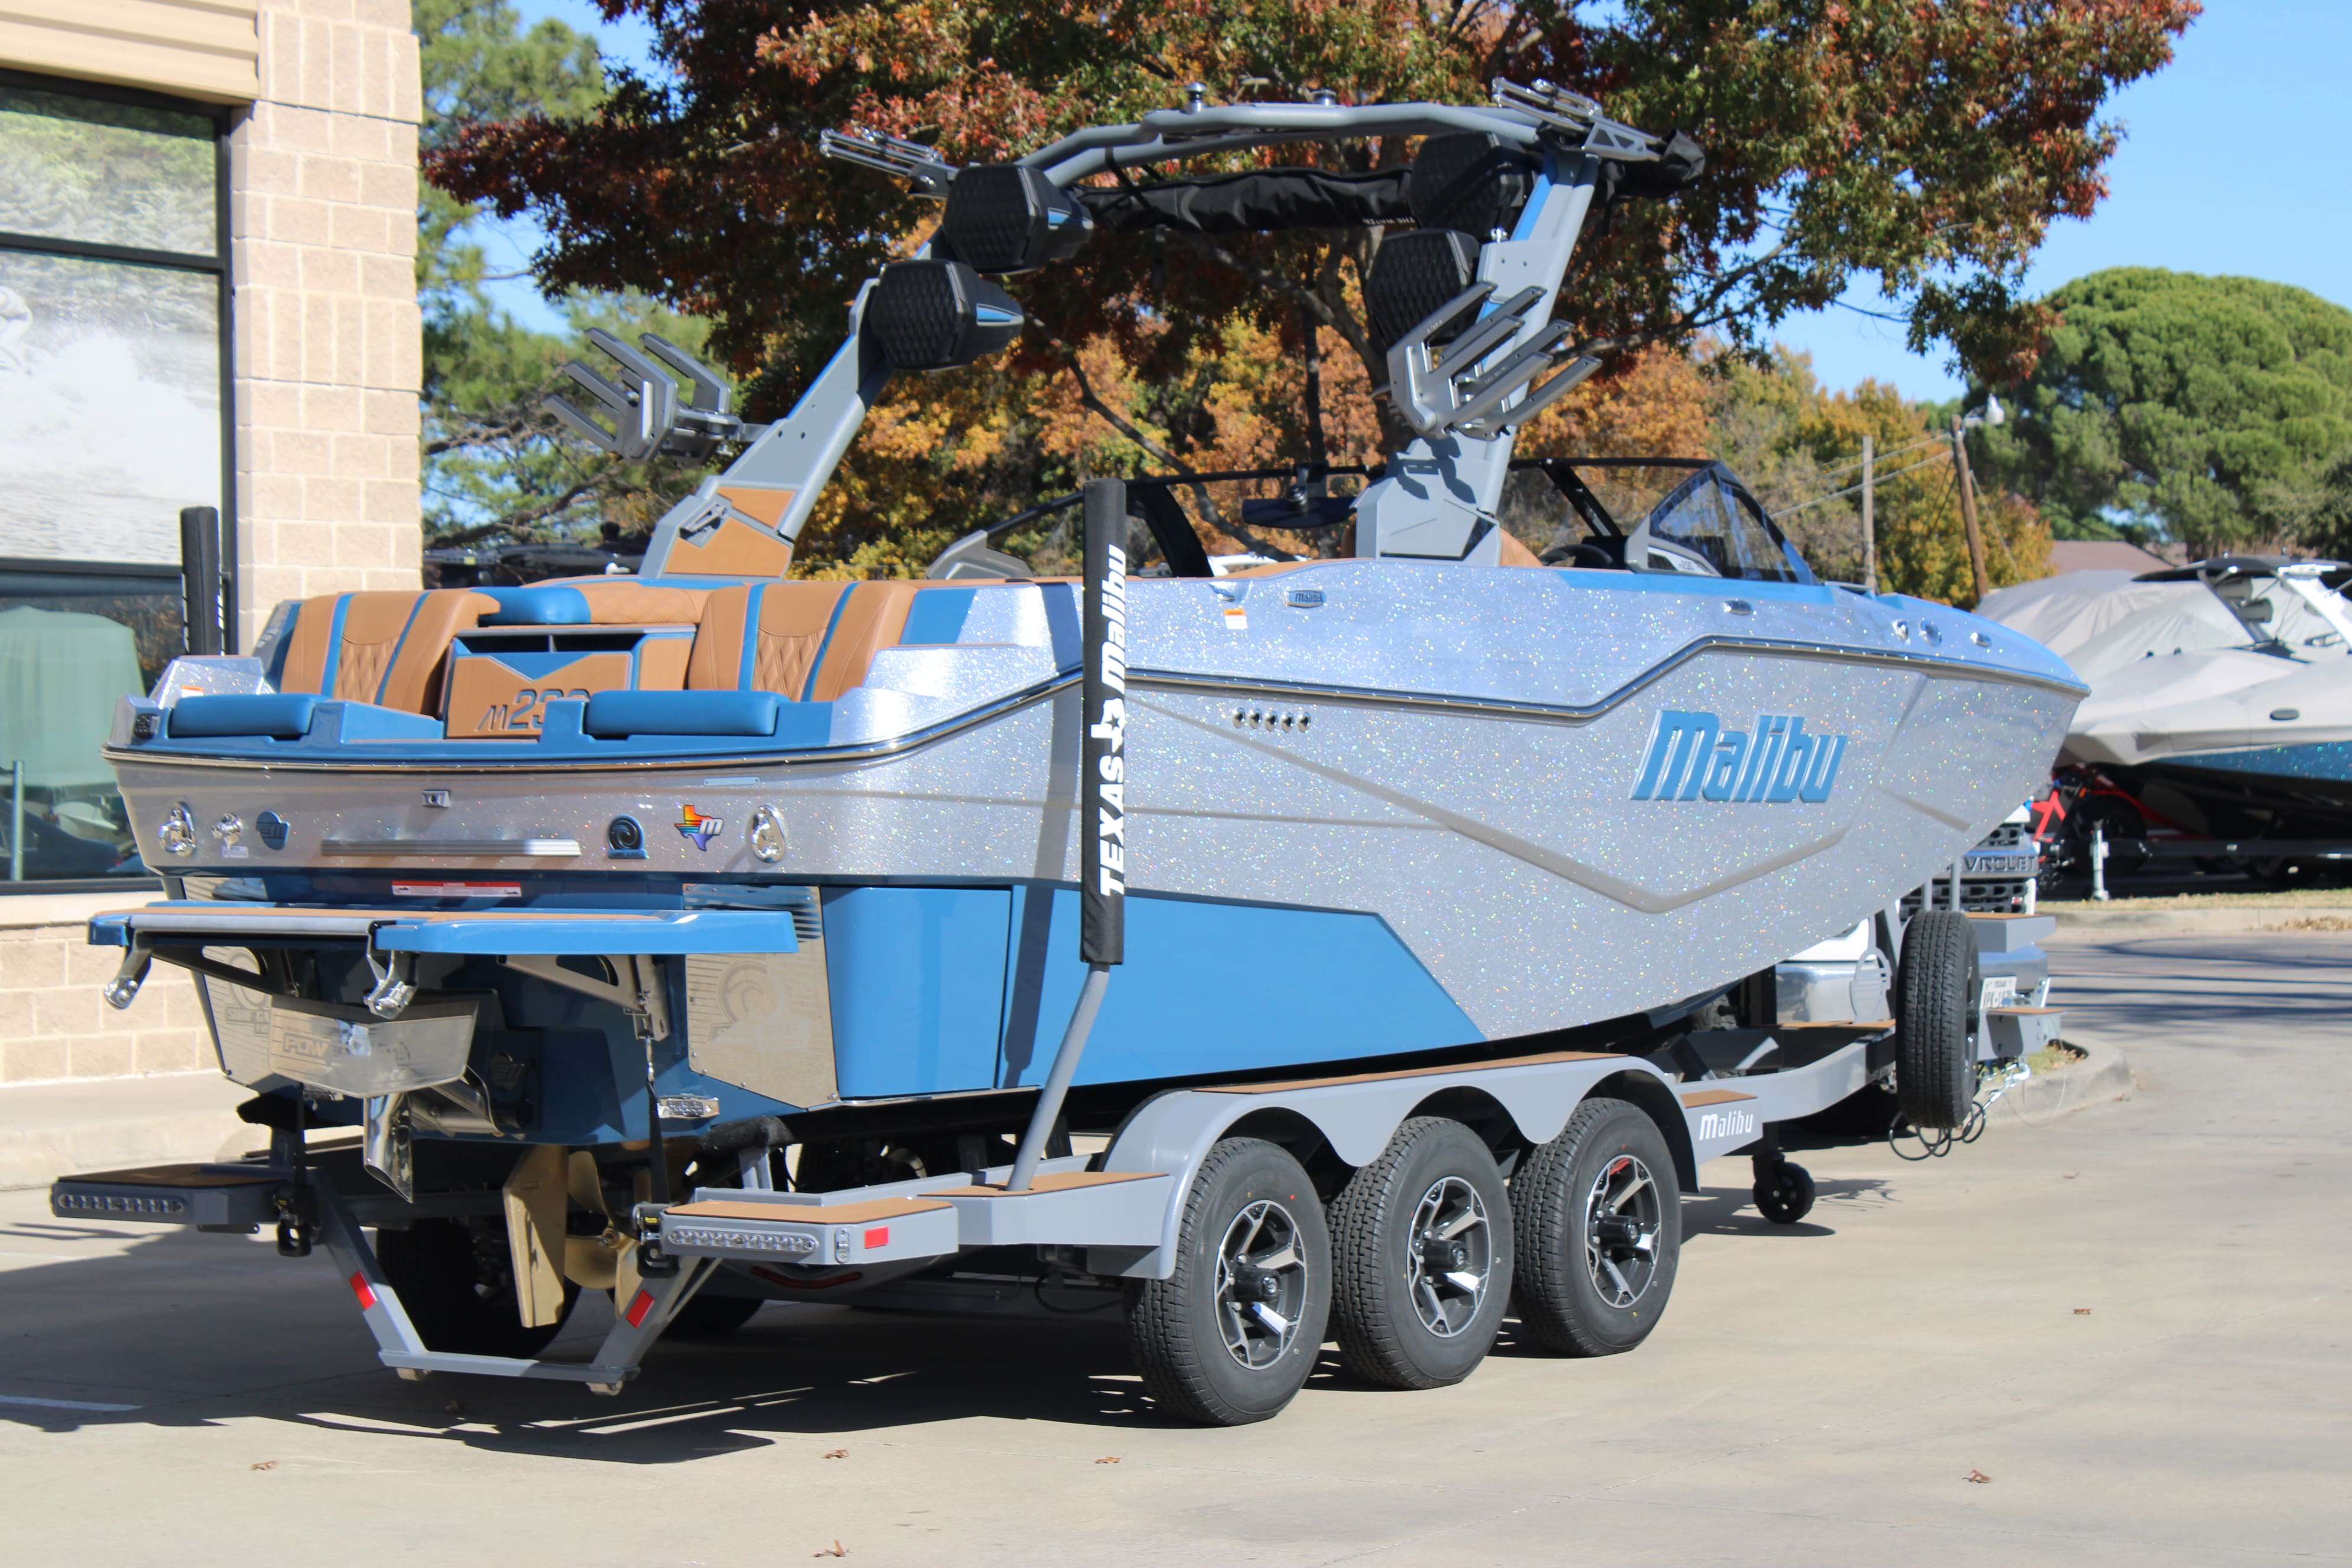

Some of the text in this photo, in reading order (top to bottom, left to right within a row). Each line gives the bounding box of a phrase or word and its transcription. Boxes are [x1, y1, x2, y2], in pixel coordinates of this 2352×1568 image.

[1099, 543, 1126, 897] TEXAS Malibu
[1629, 709, 1848, 803] Malibu
[1964, 856, 2041, 872] VROLET
[284, 1035, 331, 1057] POW
[1699, 1109, 1753, 1141] Malibu
